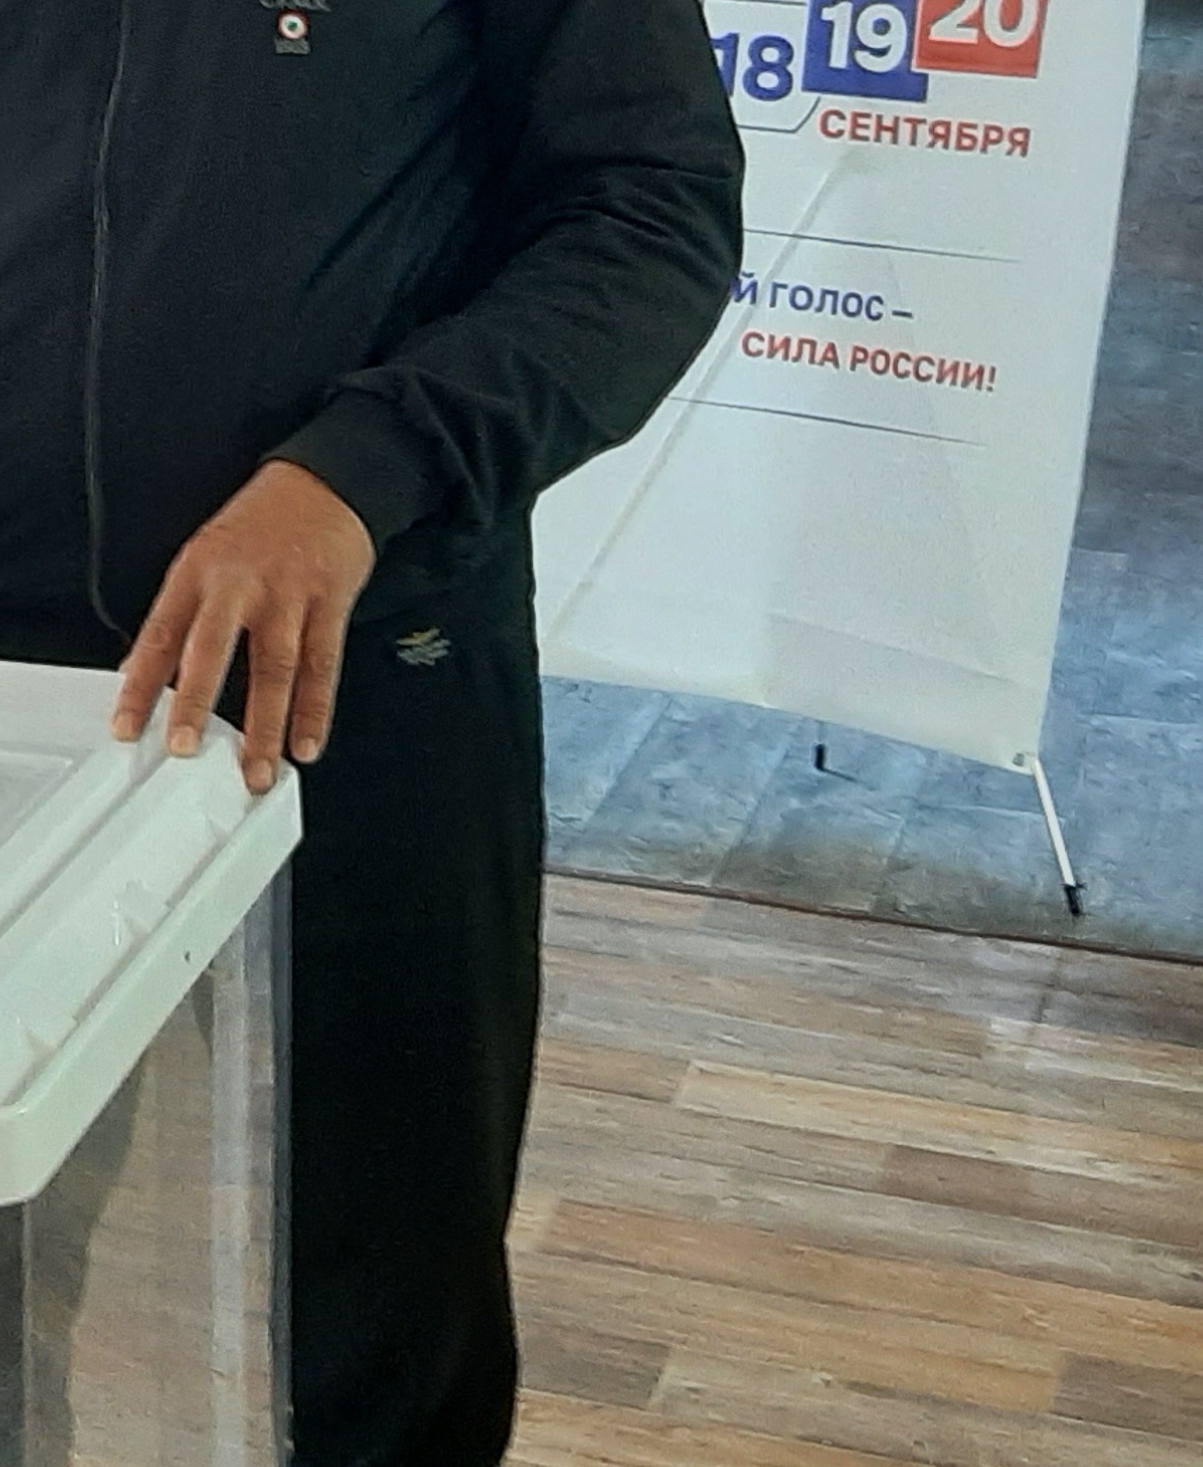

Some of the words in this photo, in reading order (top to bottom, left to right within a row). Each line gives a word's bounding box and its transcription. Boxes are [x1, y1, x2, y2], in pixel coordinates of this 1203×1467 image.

[821, 0, 908, 73] 19
[818, 109, 1031, 158] СЕНТЯБРЯ
[768, 282, 884, 321] ГОЛОС
[741, 331, 840, 370] СИЛА
[849, 344, 997, 393] РОССИИ!
